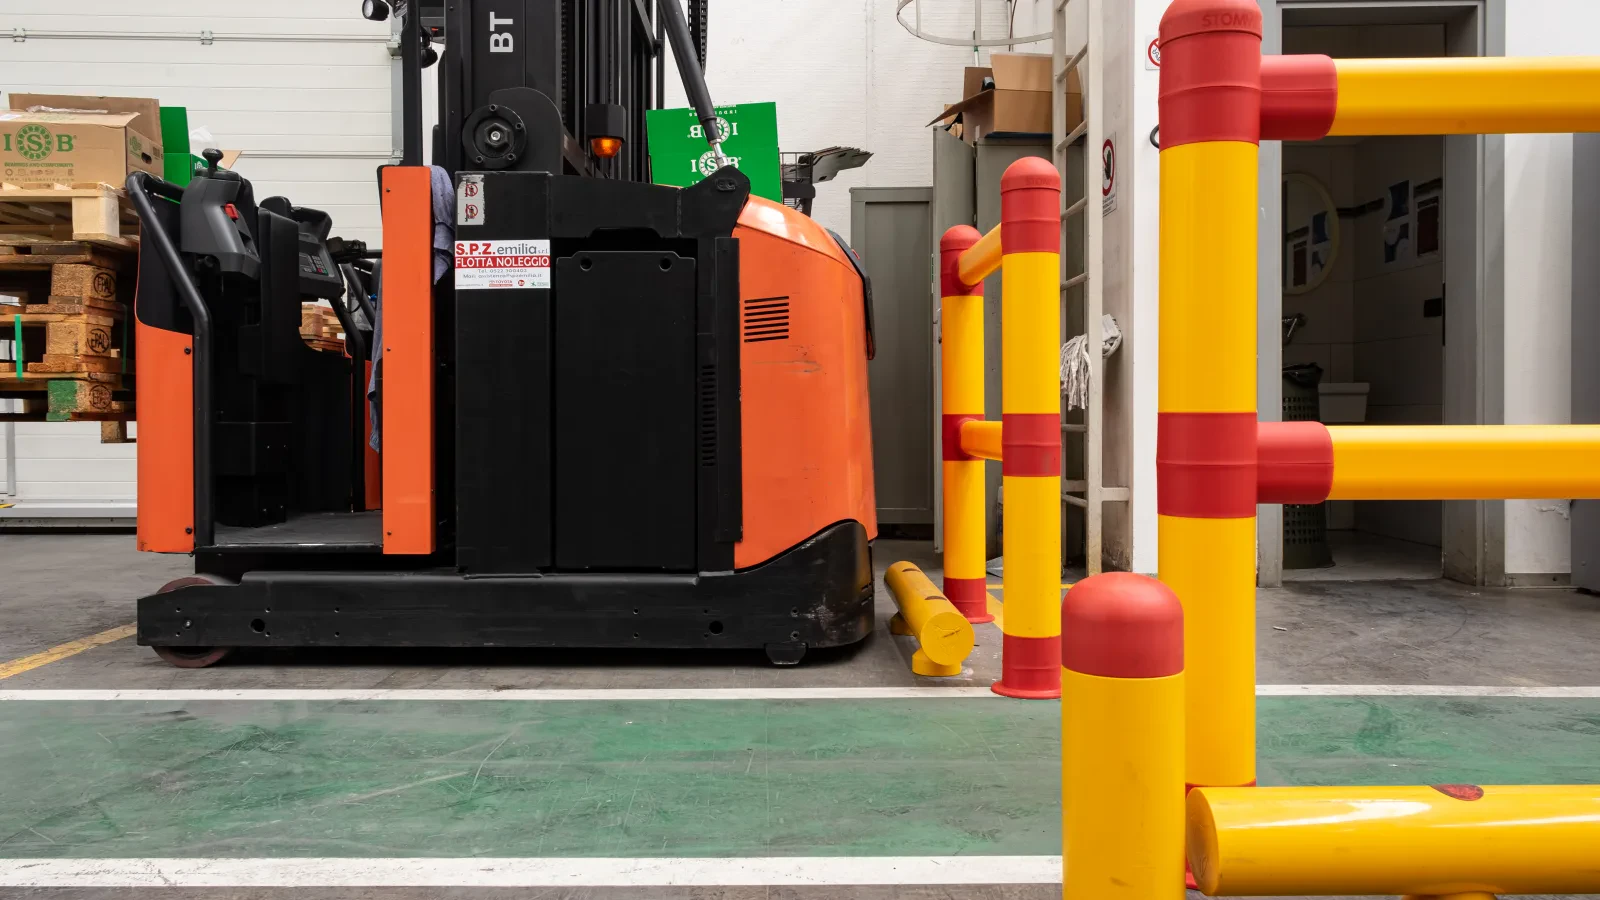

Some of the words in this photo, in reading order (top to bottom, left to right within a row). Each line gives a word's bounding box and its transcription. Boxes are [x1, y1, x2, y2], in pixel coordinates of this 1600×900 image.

[490, 11, 514, 53] BT
[3, 134, 74, 152] ISB
[456, 243, 496, 255] S.P.Z.
[497, 243, 537, 255] emilia
[455, 257, 494, 268] FLOTTA
[497, 257, 549, 267] NOLEGGIO
